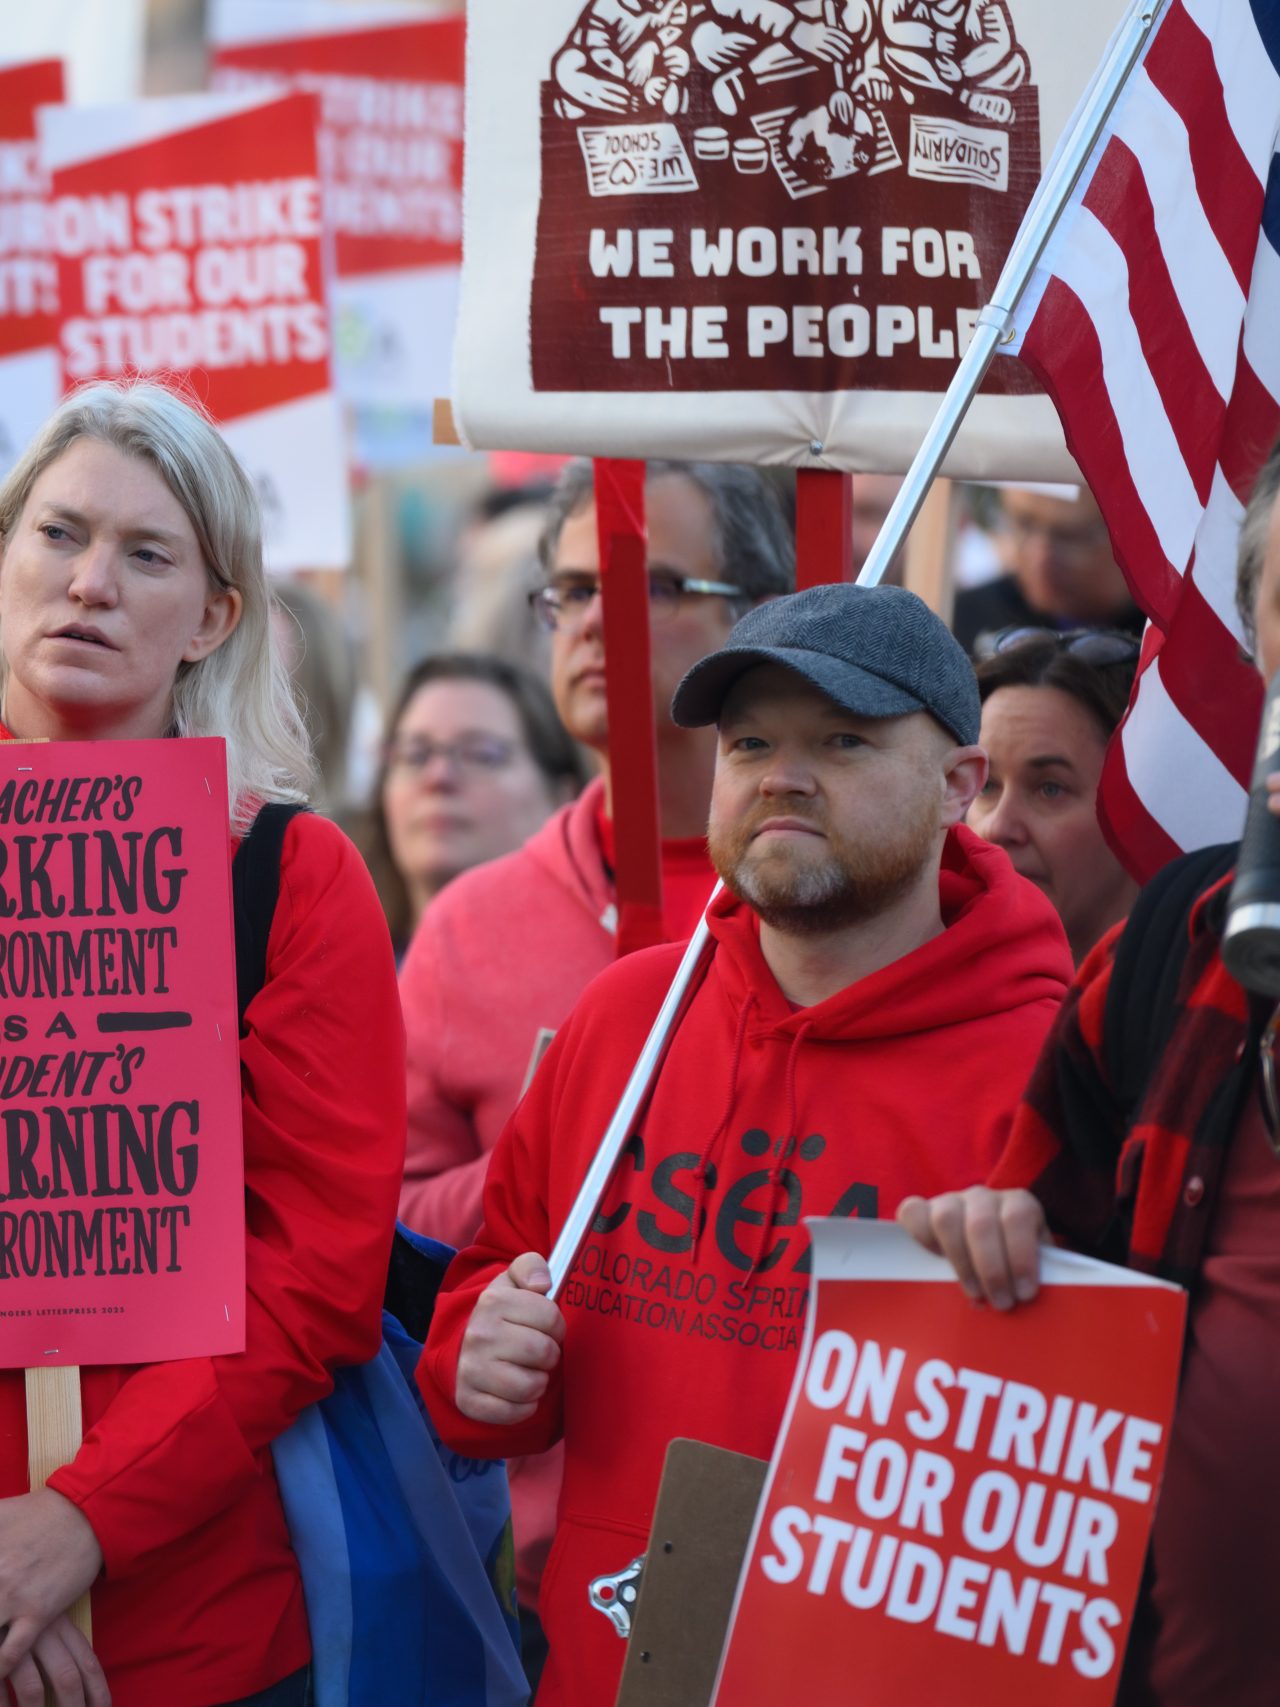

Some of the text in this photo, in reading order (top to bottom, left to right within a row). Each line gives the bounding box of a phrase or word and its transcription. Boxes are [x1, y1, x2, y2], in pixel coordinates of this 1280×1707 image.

[914, 132, 1002, 174] SOLIDARITY
[54, 176, 320, 258] ON STRIKE
[589, 226, 982, 279] WE WORK FOR
[82, 240, 310, 315] FOR OUR
[61, 302, 329, 378] STUDENTS
[599, 306, 729, 359] THE
[45, 1011, 77, 1040] A
[36, 1307, 97, 1317] LETTERPRESS
[805, 1330, 1163, 1504] ON STRIKE
[814, 1424, 1118, 1586] FOR OUR
[760, 1505, 1122, 1679] STUDENTS
